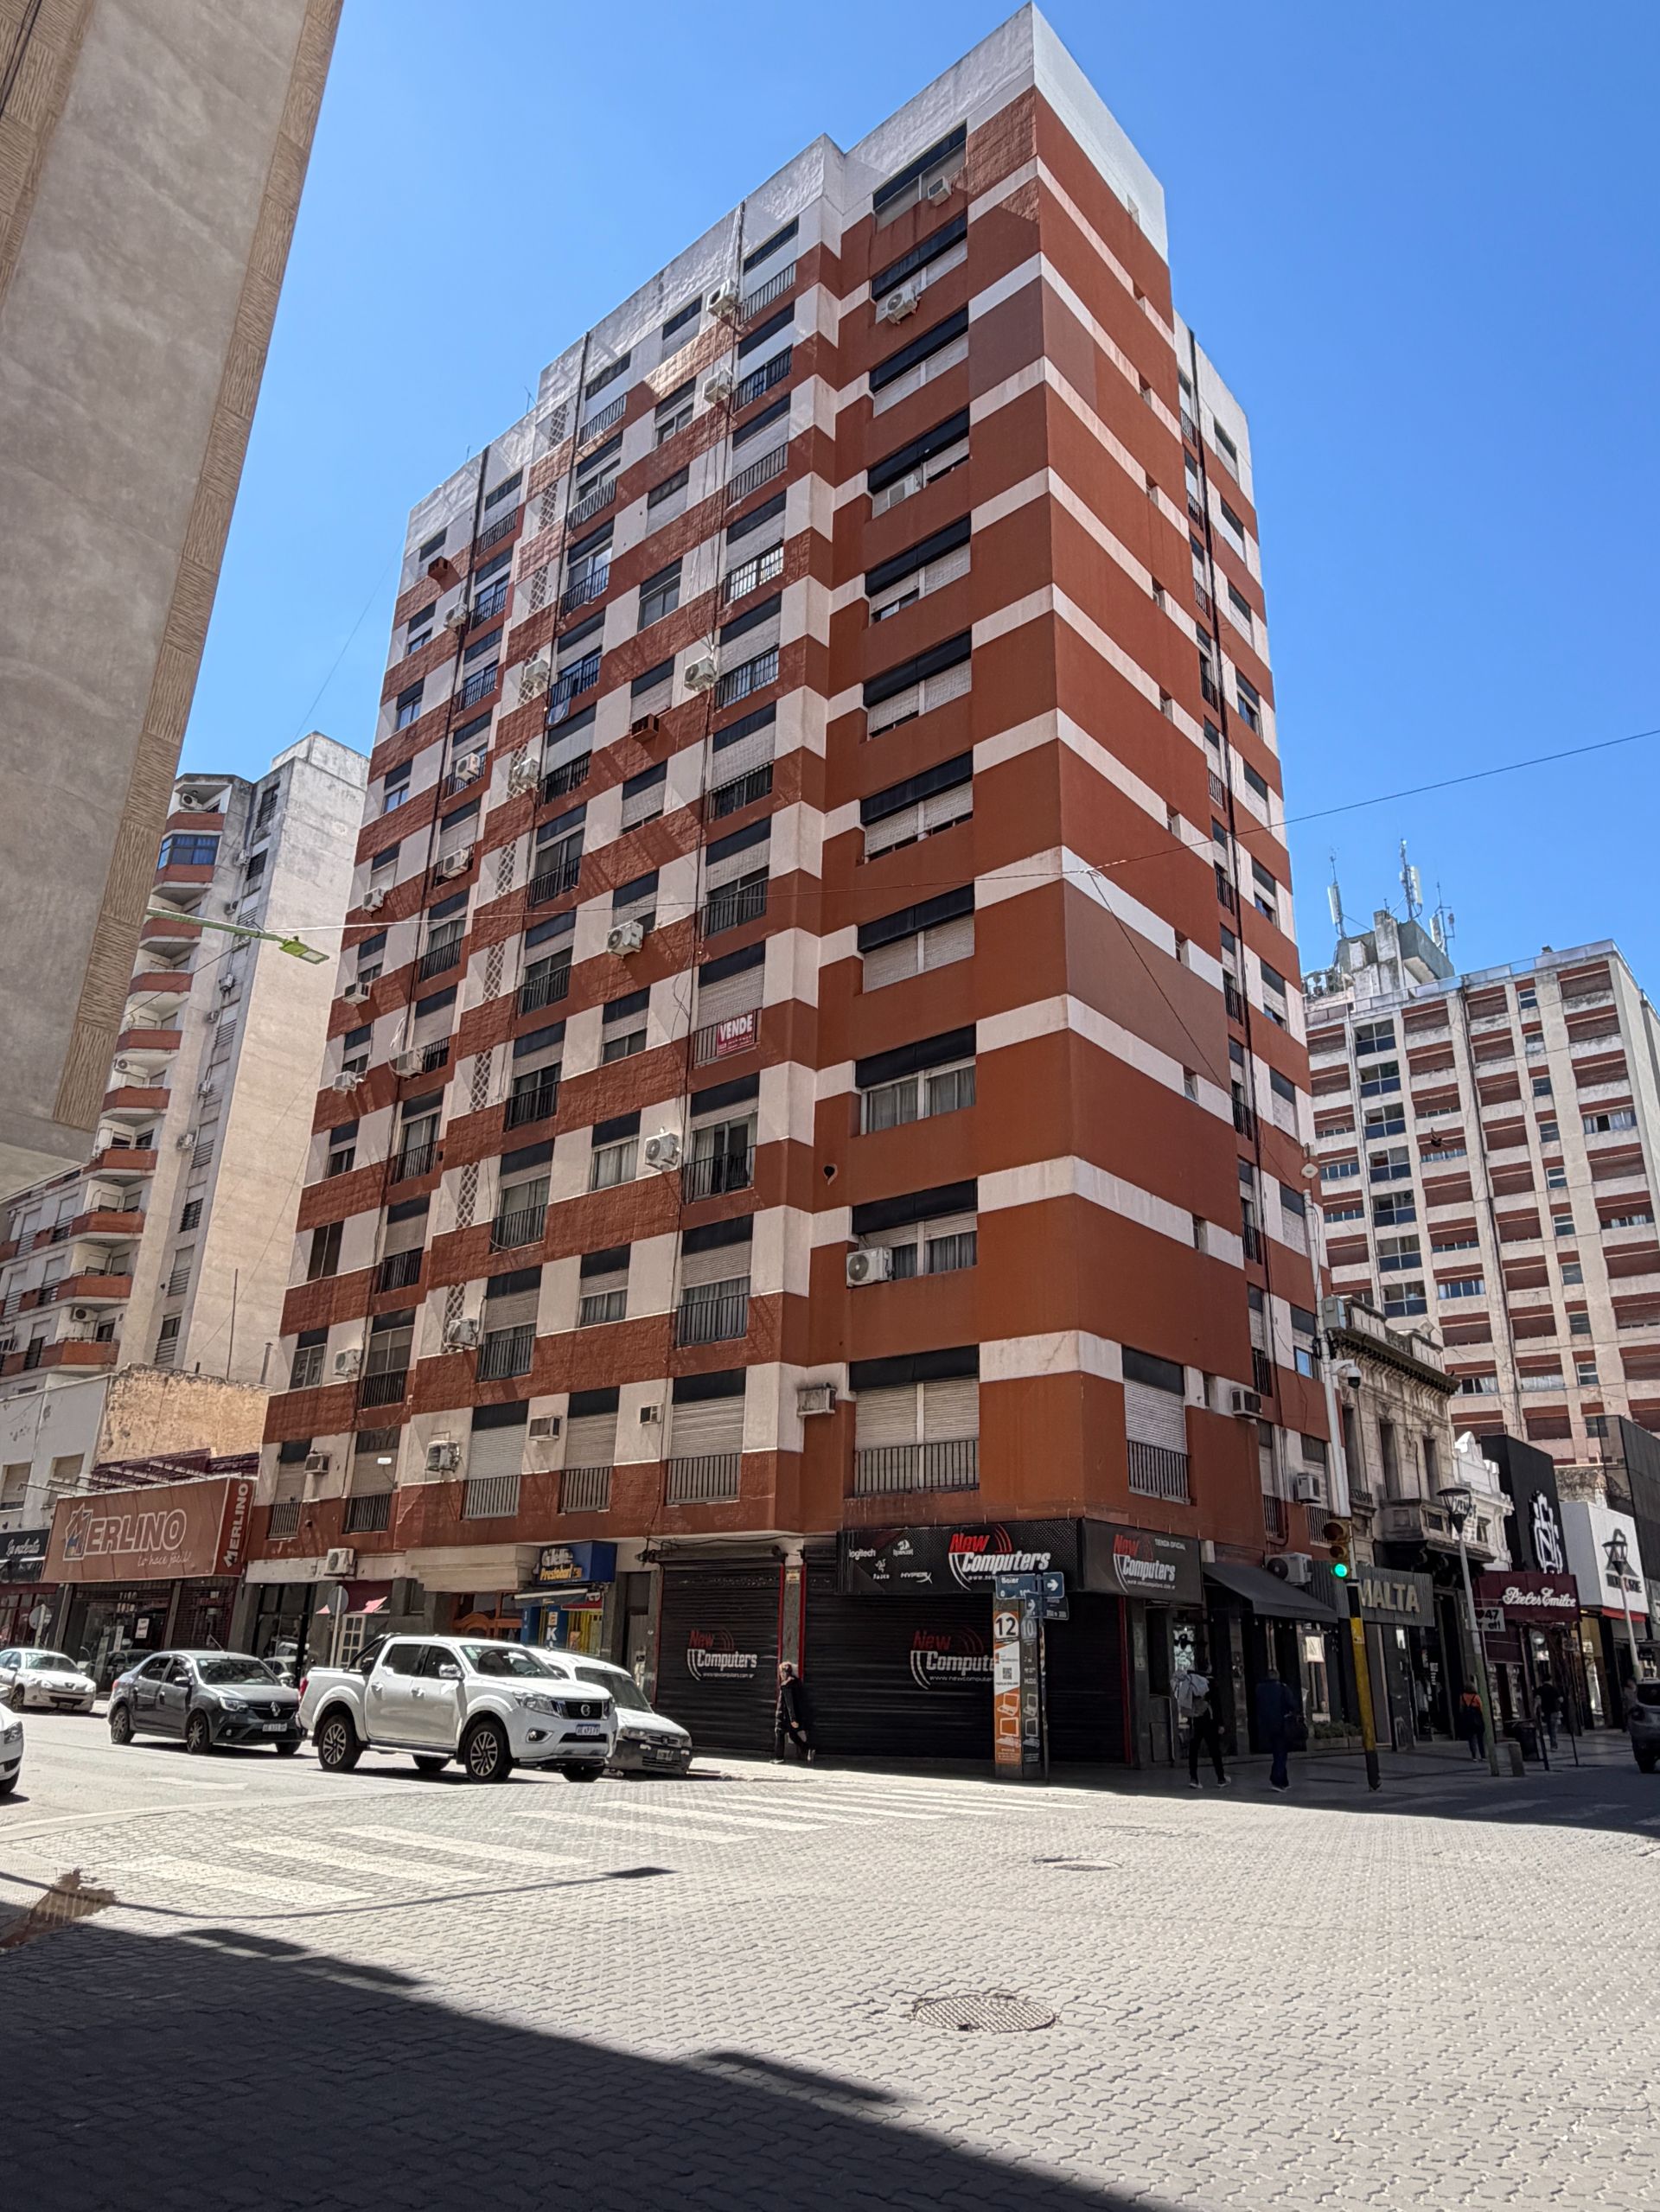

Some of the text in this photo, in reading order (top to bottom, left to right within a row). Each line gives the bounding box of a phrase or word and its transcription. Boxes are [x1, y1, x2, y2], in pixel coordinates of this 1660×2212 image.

[719, 1014, 753, 1042] VENDE
[63, 1502, 187, 1561] MERLINO
[223, 1482, 249, 1568] MERLINO
[849, 1548, 876, 1560] logitech
[950, 1533, 991, 1552] New
[1114, 1534, 1139, 1557] New
[961, 1550, 1051, 1574] Computers
[1123, 1554, 1176, 1582] Computers
[1361, 1578, 1421, 1614] MALTA
[1503, 1586, 1542, 1606] Pieles
[996, 1616, 1017, 1636] 12
[913, 1630, 951, 1650] New
[696, 1648, 758, 1672] Computers
[926, 1650, 994, 1676] Compute
